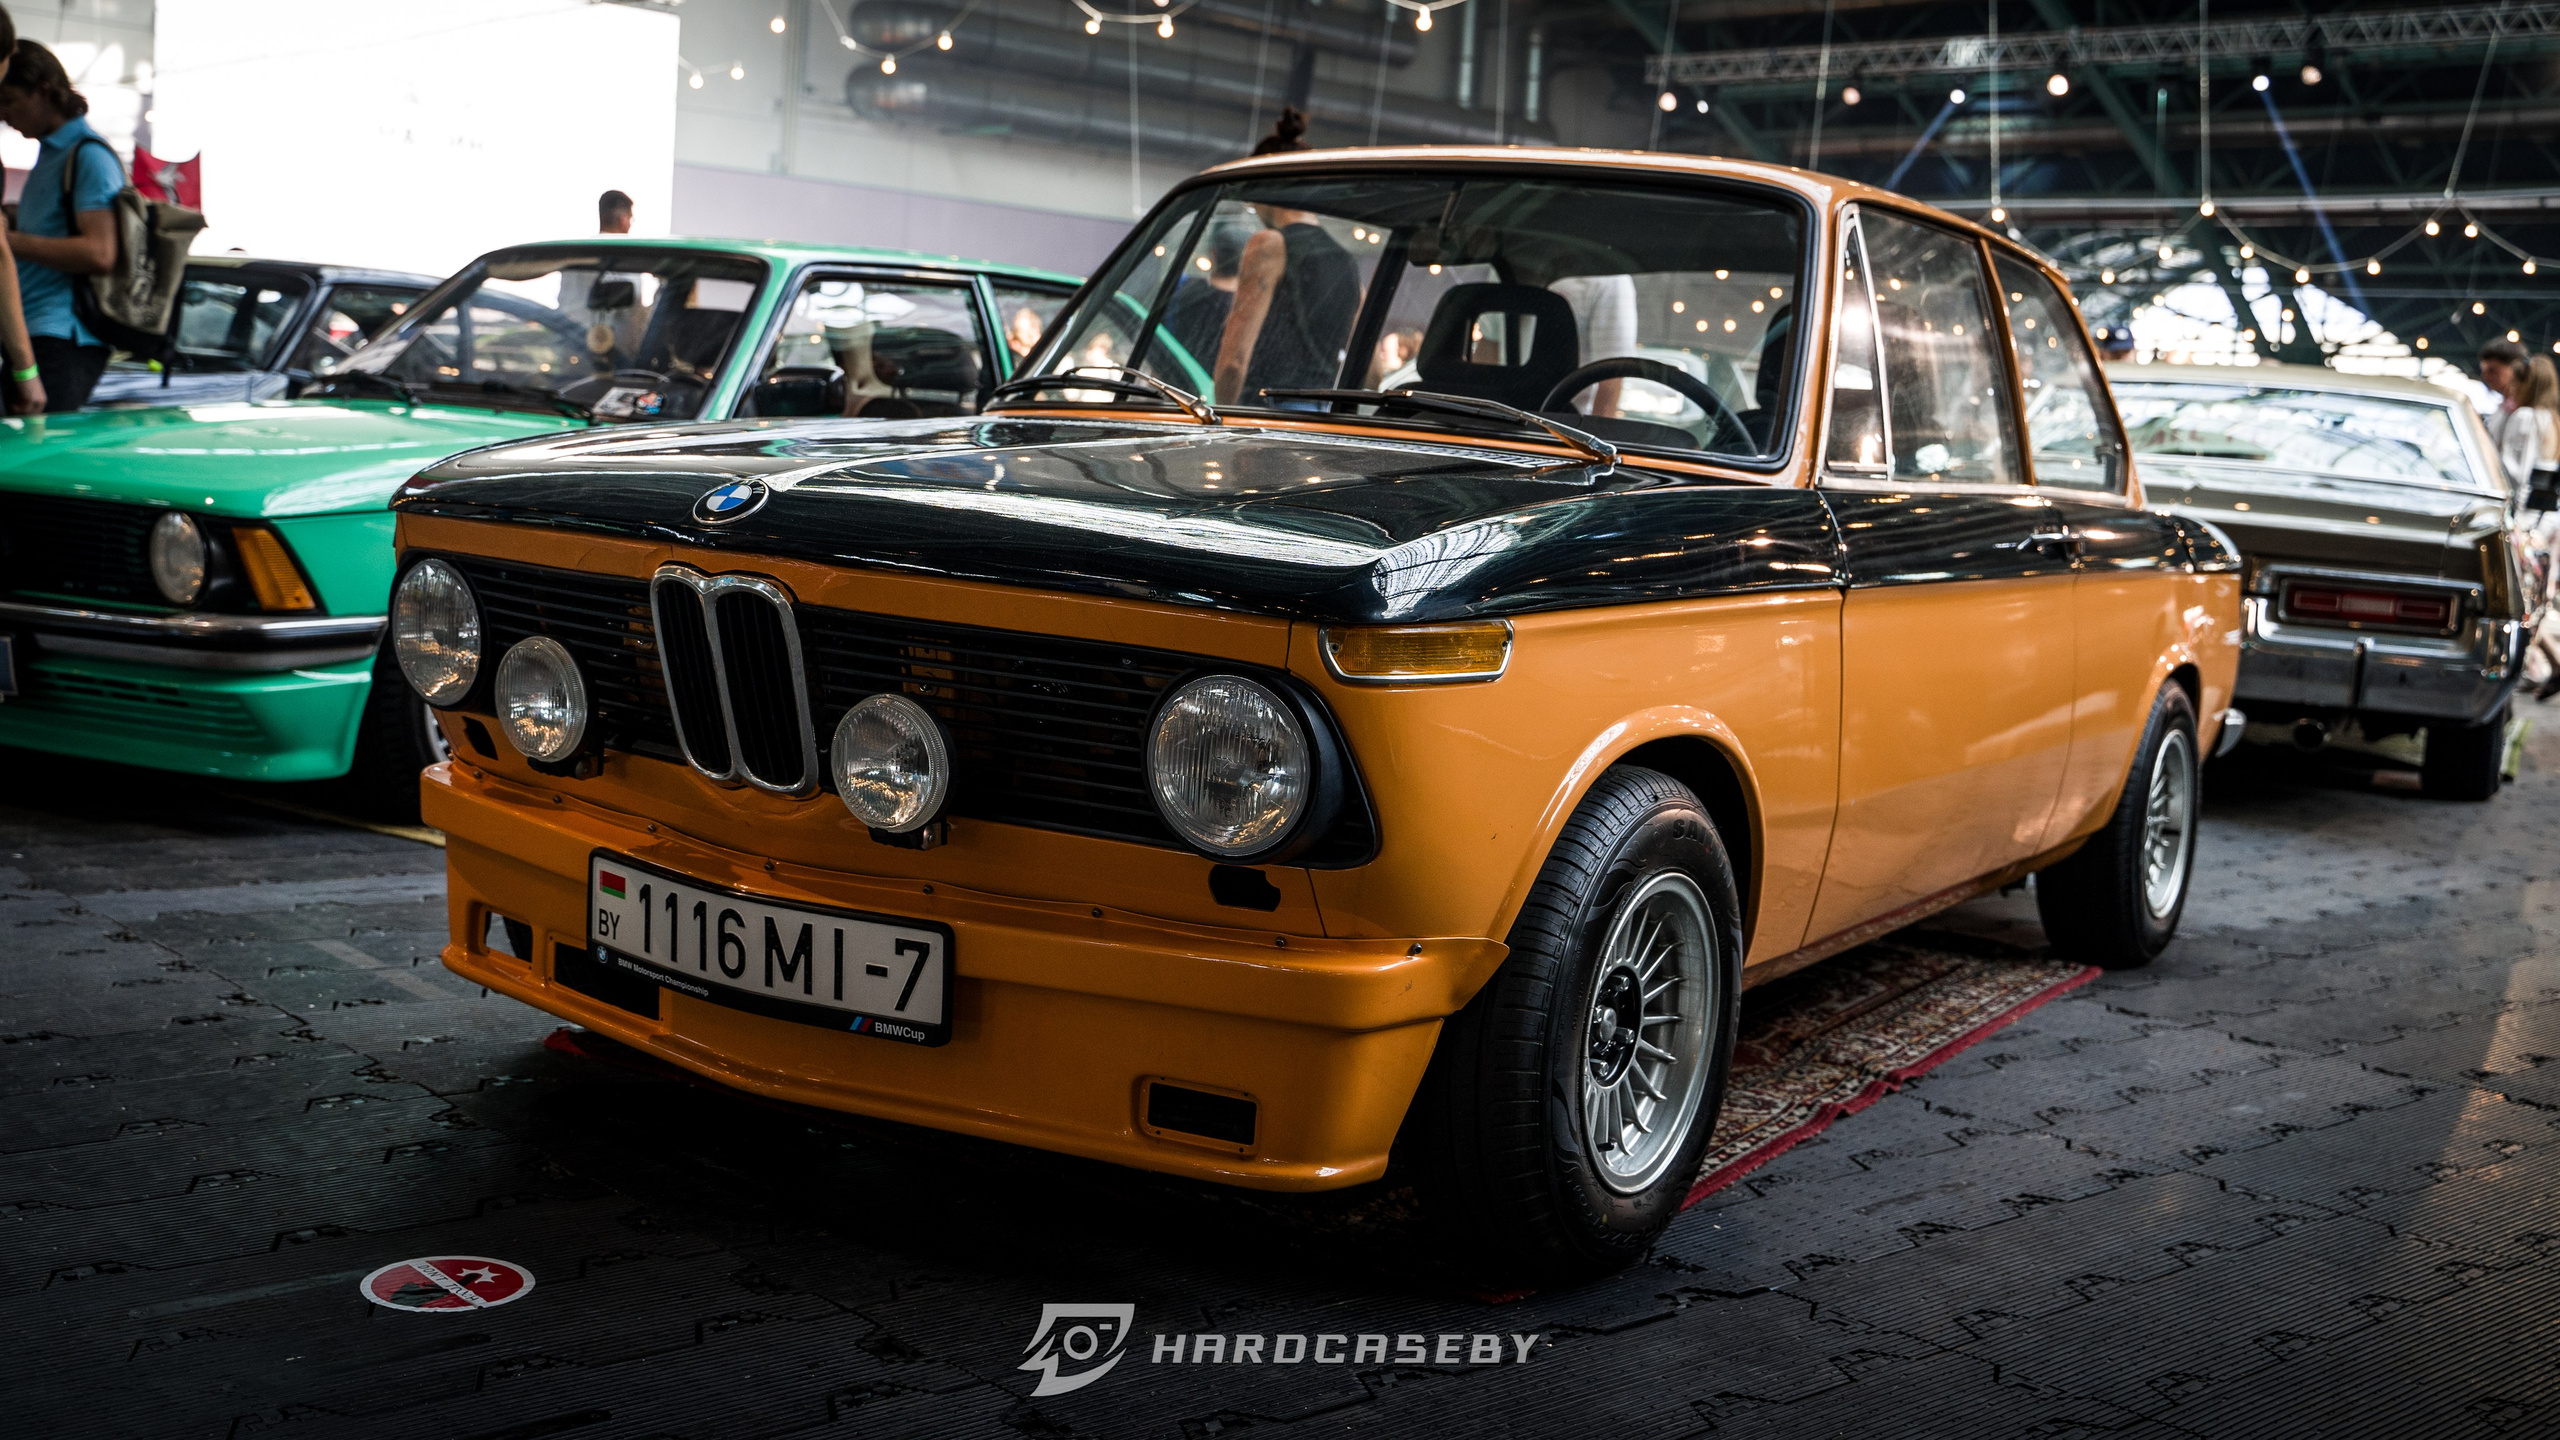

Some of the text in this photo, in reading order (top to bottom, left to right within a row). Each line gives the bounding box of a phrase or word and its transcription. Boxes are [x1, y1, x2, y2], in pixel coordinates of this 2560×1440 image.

[598, 908, 621, 940] BY
[639, 884, 747, 980] 1116
[618, 957, 709, 997] BMW Motorsport Championship
[874, 1021, 926, 1042] BMWCup
